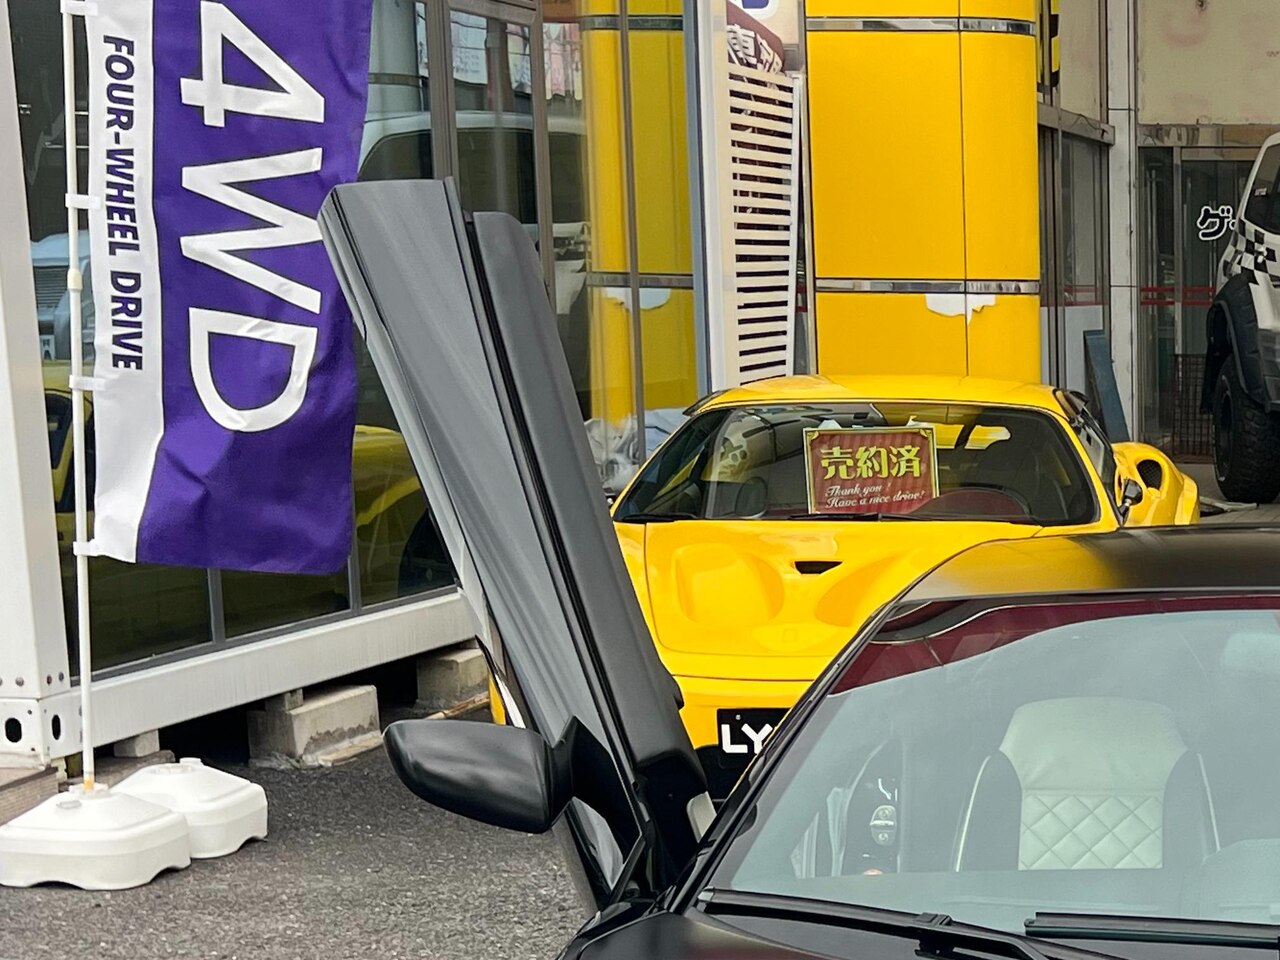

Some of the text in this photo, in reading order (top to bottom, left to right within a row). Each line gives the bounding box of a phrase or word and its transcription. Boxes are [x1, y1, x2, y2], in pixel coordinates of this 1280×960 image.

[103, 35, 143, 371] FOUR-WHEEL DRIVE
[180, 1, 325, 432] 4WD
[1196, 206, 1237, 240] ゲ
[820, 445, 921, 480] 売約済
[825, 484, 861, 497] Thank
[825, 496, 857, 508] Have
[869, 494, 892, 504] nice
[893, 490, 925, 502] drive!
[721, 723, 773, 754] LY
